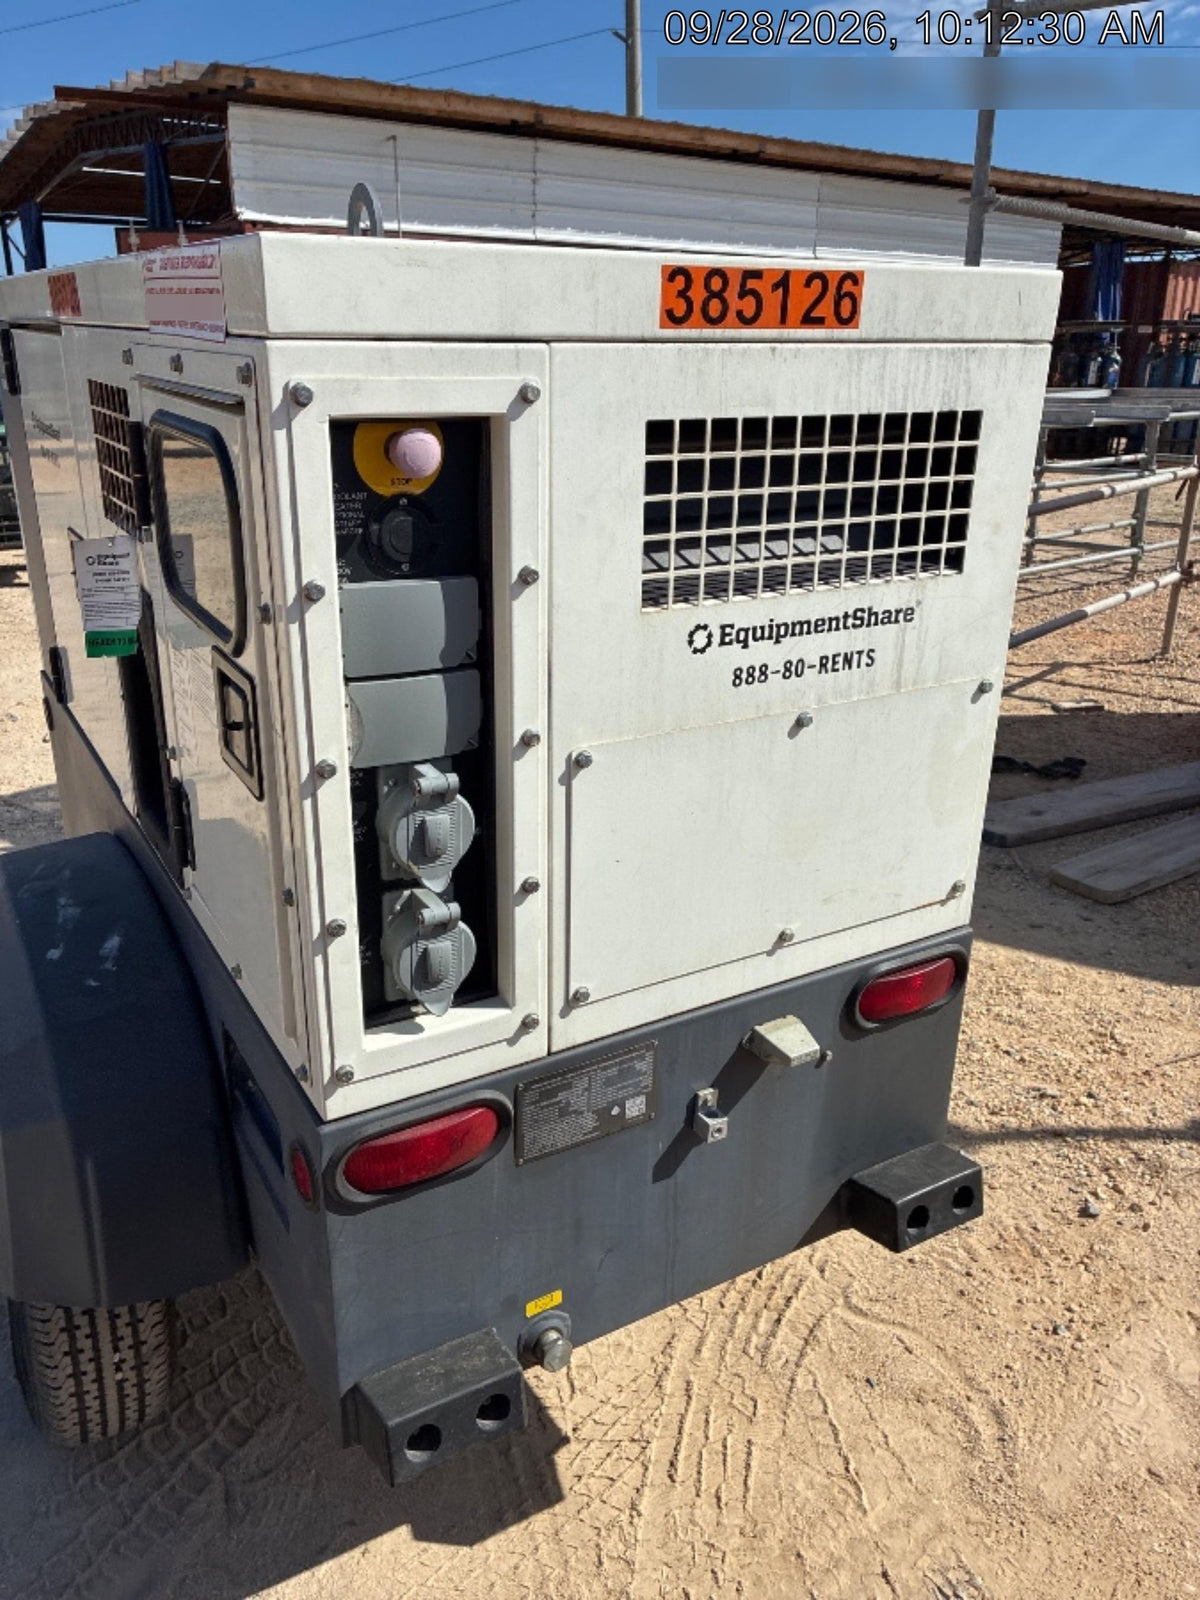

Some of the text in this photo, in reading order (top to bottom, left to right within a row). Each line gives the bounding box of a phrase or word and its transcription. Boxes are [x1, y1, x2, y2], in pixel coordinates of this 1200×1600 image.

[665, 266, 860, 326] 385126
[390, 477, 413, 486] STOP
[718, 606, 915, 649] EquipmentShare
[731, 649, 876, 688] 888-80-RENTS
